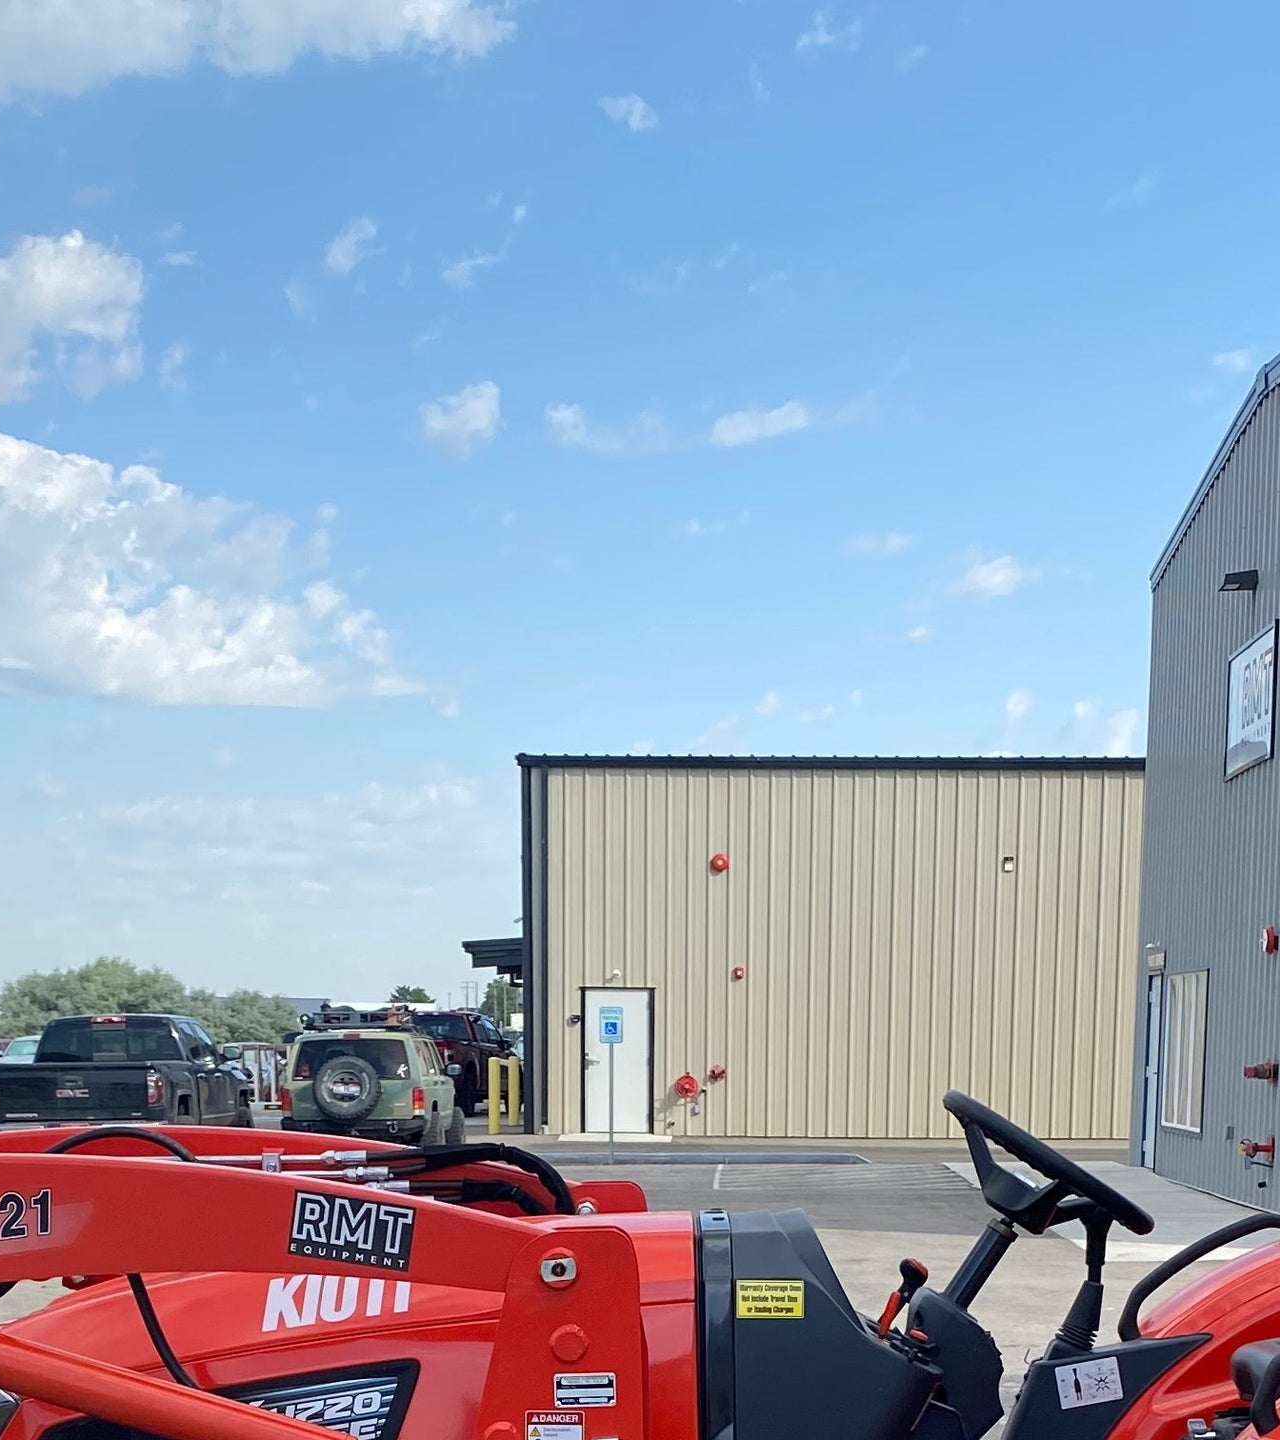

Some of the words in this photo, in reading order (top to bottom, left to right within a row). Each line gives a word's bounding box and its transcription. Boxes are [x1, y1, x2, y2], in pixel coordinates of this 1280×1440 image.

[292, 1192, 414, 1254] RMT
[289, 1242, 406, 1269] EQUIPMENT
[540, 1414, 579, 1423] DANGER
